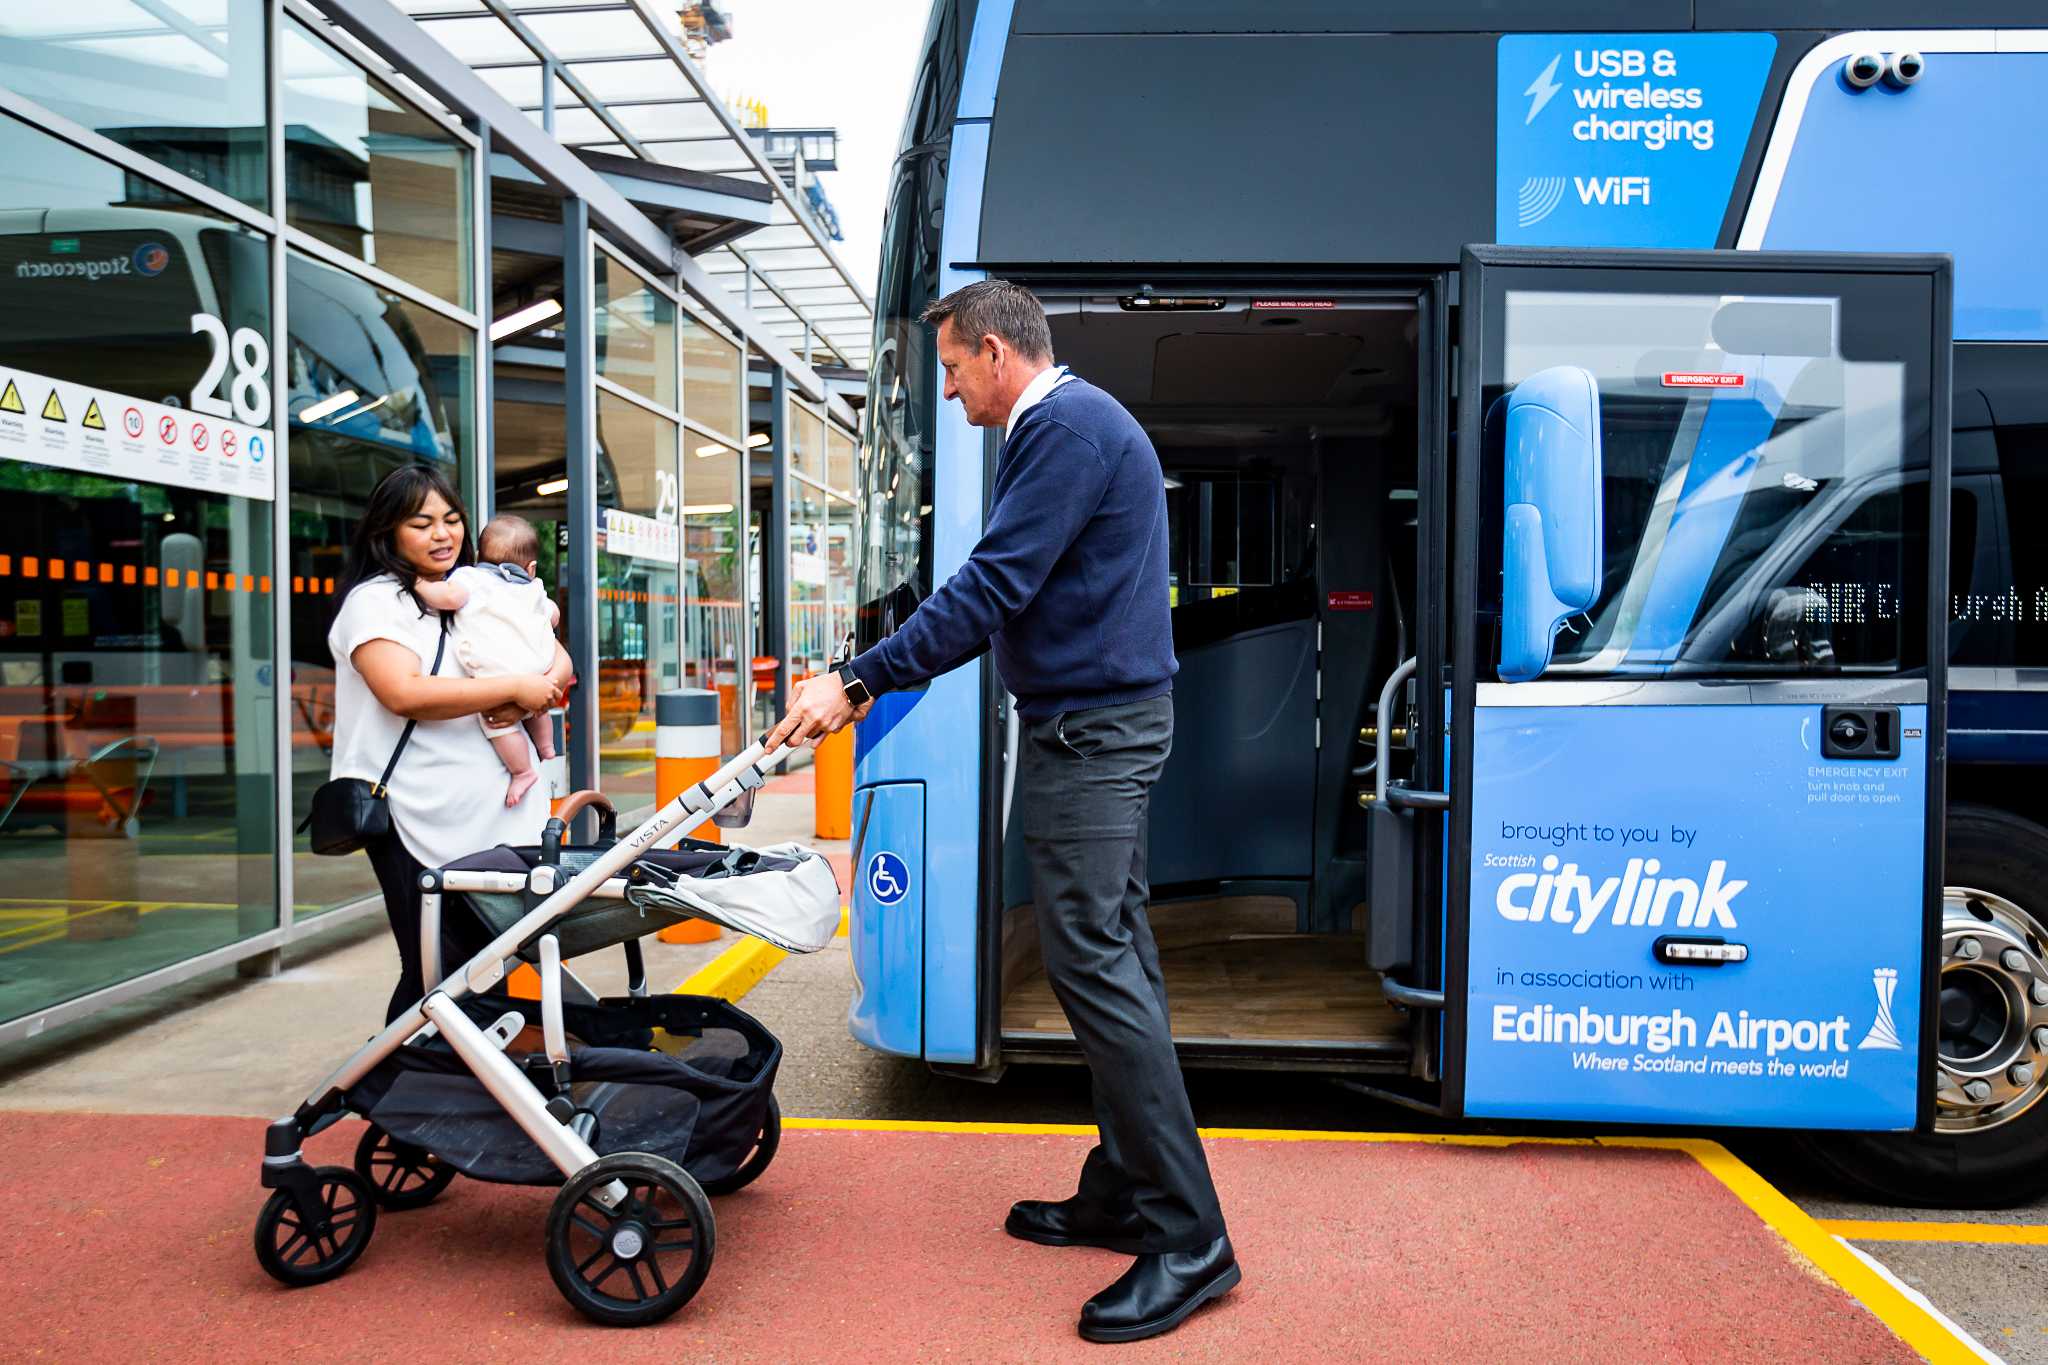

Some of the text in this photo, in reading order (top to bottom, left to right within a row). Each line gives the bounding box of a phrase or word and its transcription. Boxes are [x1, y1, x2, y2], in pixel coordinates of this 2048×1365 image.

[1574, 49, 1677, 78] USB &
[1572, 81, 1703, 109] wireless
[1572, 113, 1714, 150] charging
[1573, 176, 1650, 205] WiFi
[191, 313, 271, 427] 28
[1671, 375, 1738, 385] EMERGENCY EXIT
[655, 470, 677, 524] 29
[1806, 582, 1865, 623] AIR
[1807, 766, 1909, 778] EMERGENCY EXIT
[1807, 781, 1885, 792] turn knob and
[1807, 792, 1901, 805] pull door to open
[630, 819, 669, 848] VISTA
[1501, 821, 1697, 848] brought to you by
[1483, 852, 1536, 868] Scottish
[1496, 854, 1748, 934] citylink
[1497, 967, 1694, 991] in association with
[1492, 1004, 1850, 1056] Edinburgh Airport
[1572, 1052, 1849, 1078] Where Scotland meets the world
